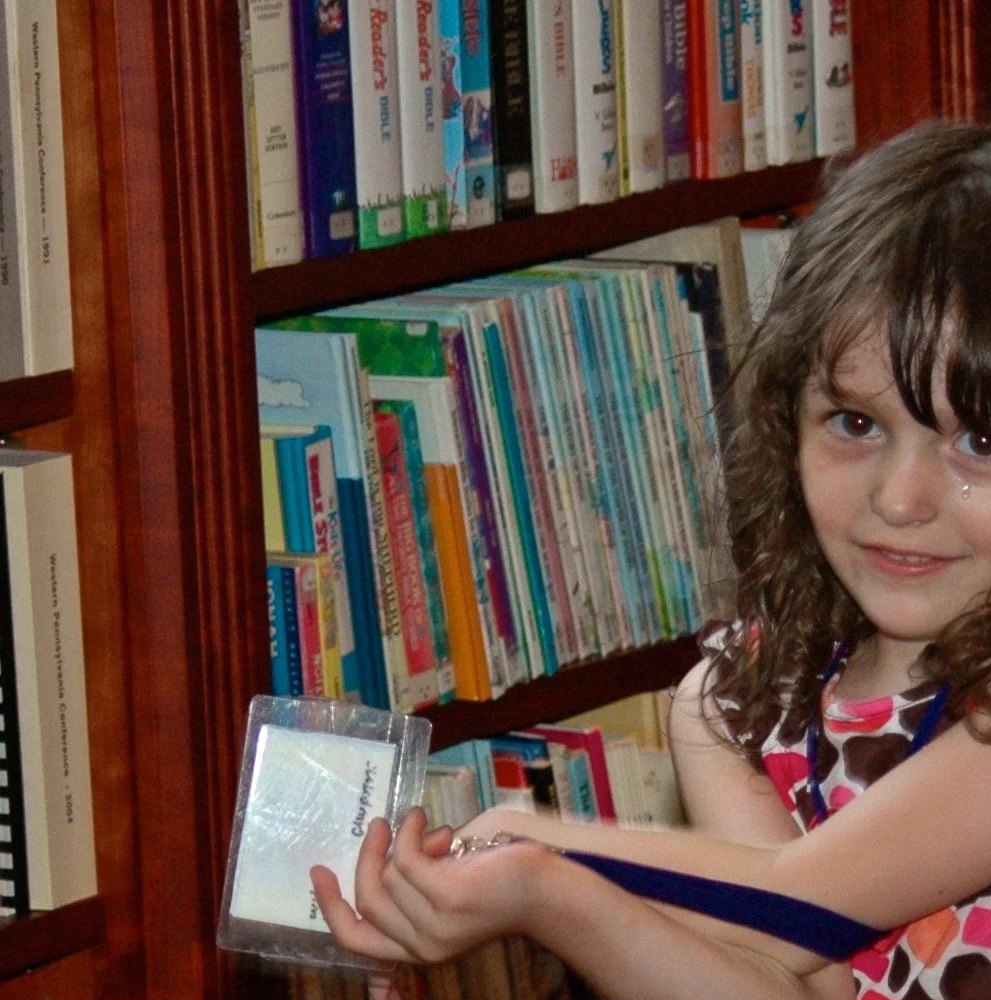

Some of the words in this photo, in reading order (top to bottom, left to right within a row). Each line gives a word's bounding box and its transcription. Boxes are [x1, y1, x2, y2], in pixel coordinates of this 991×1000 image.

[31, 22, 41, 68] Western
[369, 7, 390, 90] Reader's
[415, 0, 435, 81] Reader's
[549, 21, 570, 78] BIBLE
[673, 4, 687, 70] Bible
[724, 33, 736, 89] Bible
[32, 72, 45, 146] Pennsylvania
[379, 96, 390, 143] BIBLE
[423, 87, 435, 132] BIBLE
[37, 149, 48, 213] Conference
[42, 236, 51, 264] 1991
[47, 553, 58, 607] Western
[50, 611, 65, 698] Pennsylvania
[58, 702, 71, 777] Conference
